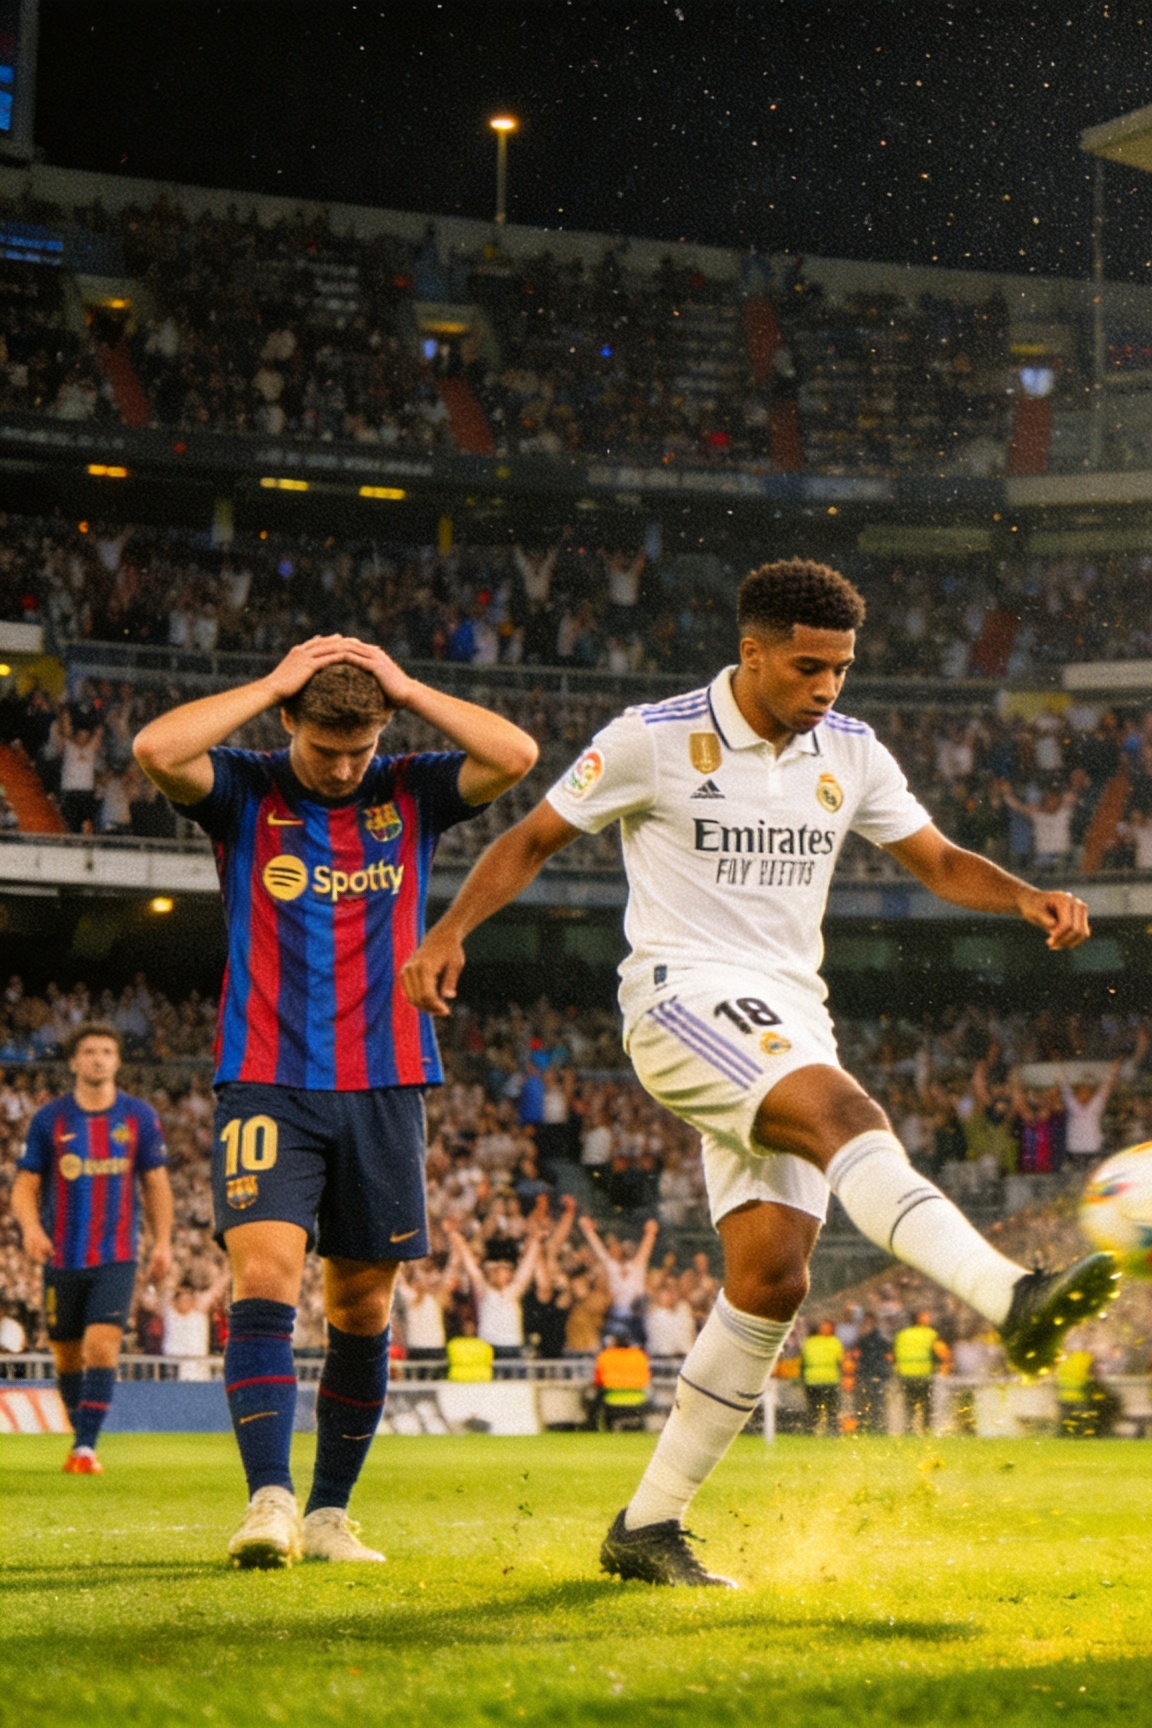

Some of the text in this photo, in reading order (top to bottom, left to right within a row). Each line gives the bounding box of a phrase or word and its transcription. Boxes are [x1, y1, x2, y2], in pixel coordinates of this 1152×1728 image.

[692, 818, 836, 856] Emirates
[713, 997, 783, 1034] 18
[220, 1114, 278, 1177] 10
